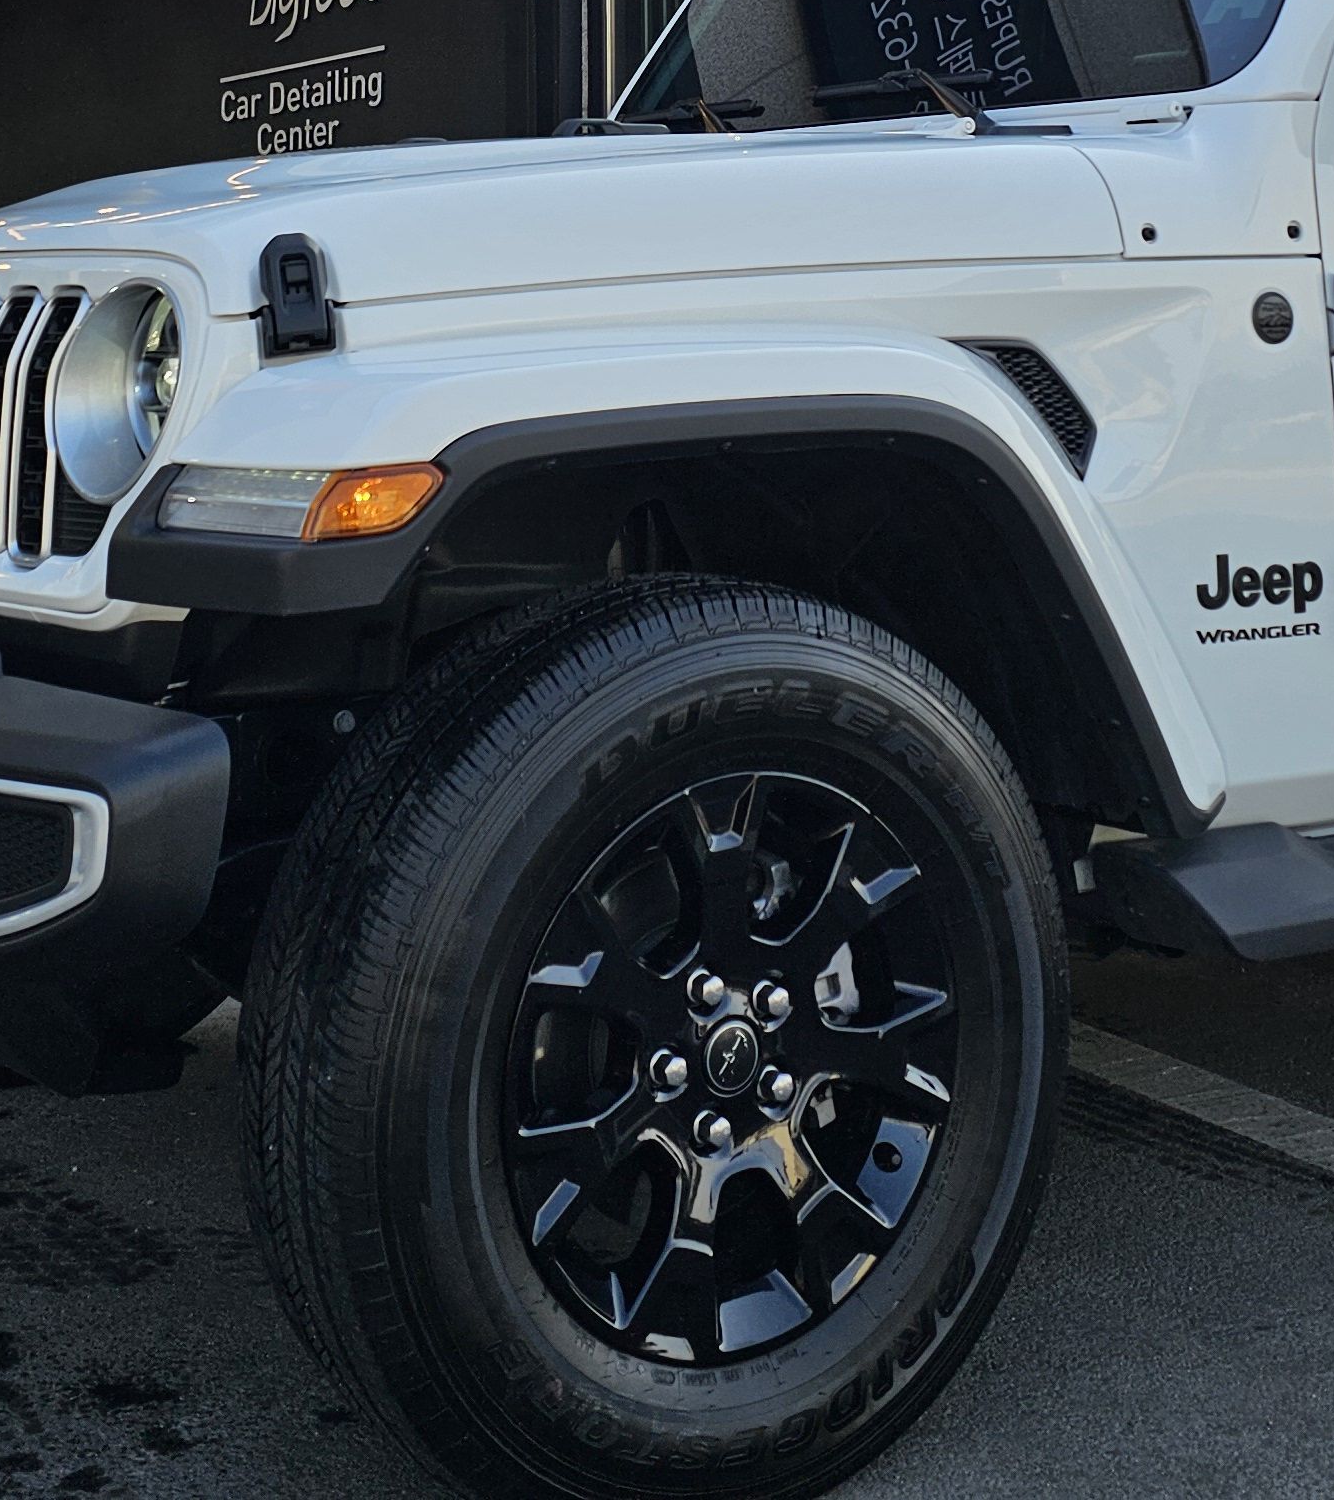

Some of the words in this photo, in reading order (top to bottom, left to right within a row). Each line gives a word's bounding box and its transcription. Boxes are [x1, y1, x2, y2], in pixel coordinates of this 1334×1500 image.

[220, 90, 262, 122] Car
[269, 67, 383, 115] Detailing
[257, 119, 340, 156] Center
[1196, 553, 1323, 614] Jeep
[1196, 622, 1322, 645] WRANGLER
[579, 677, 942, 796] DUELER
